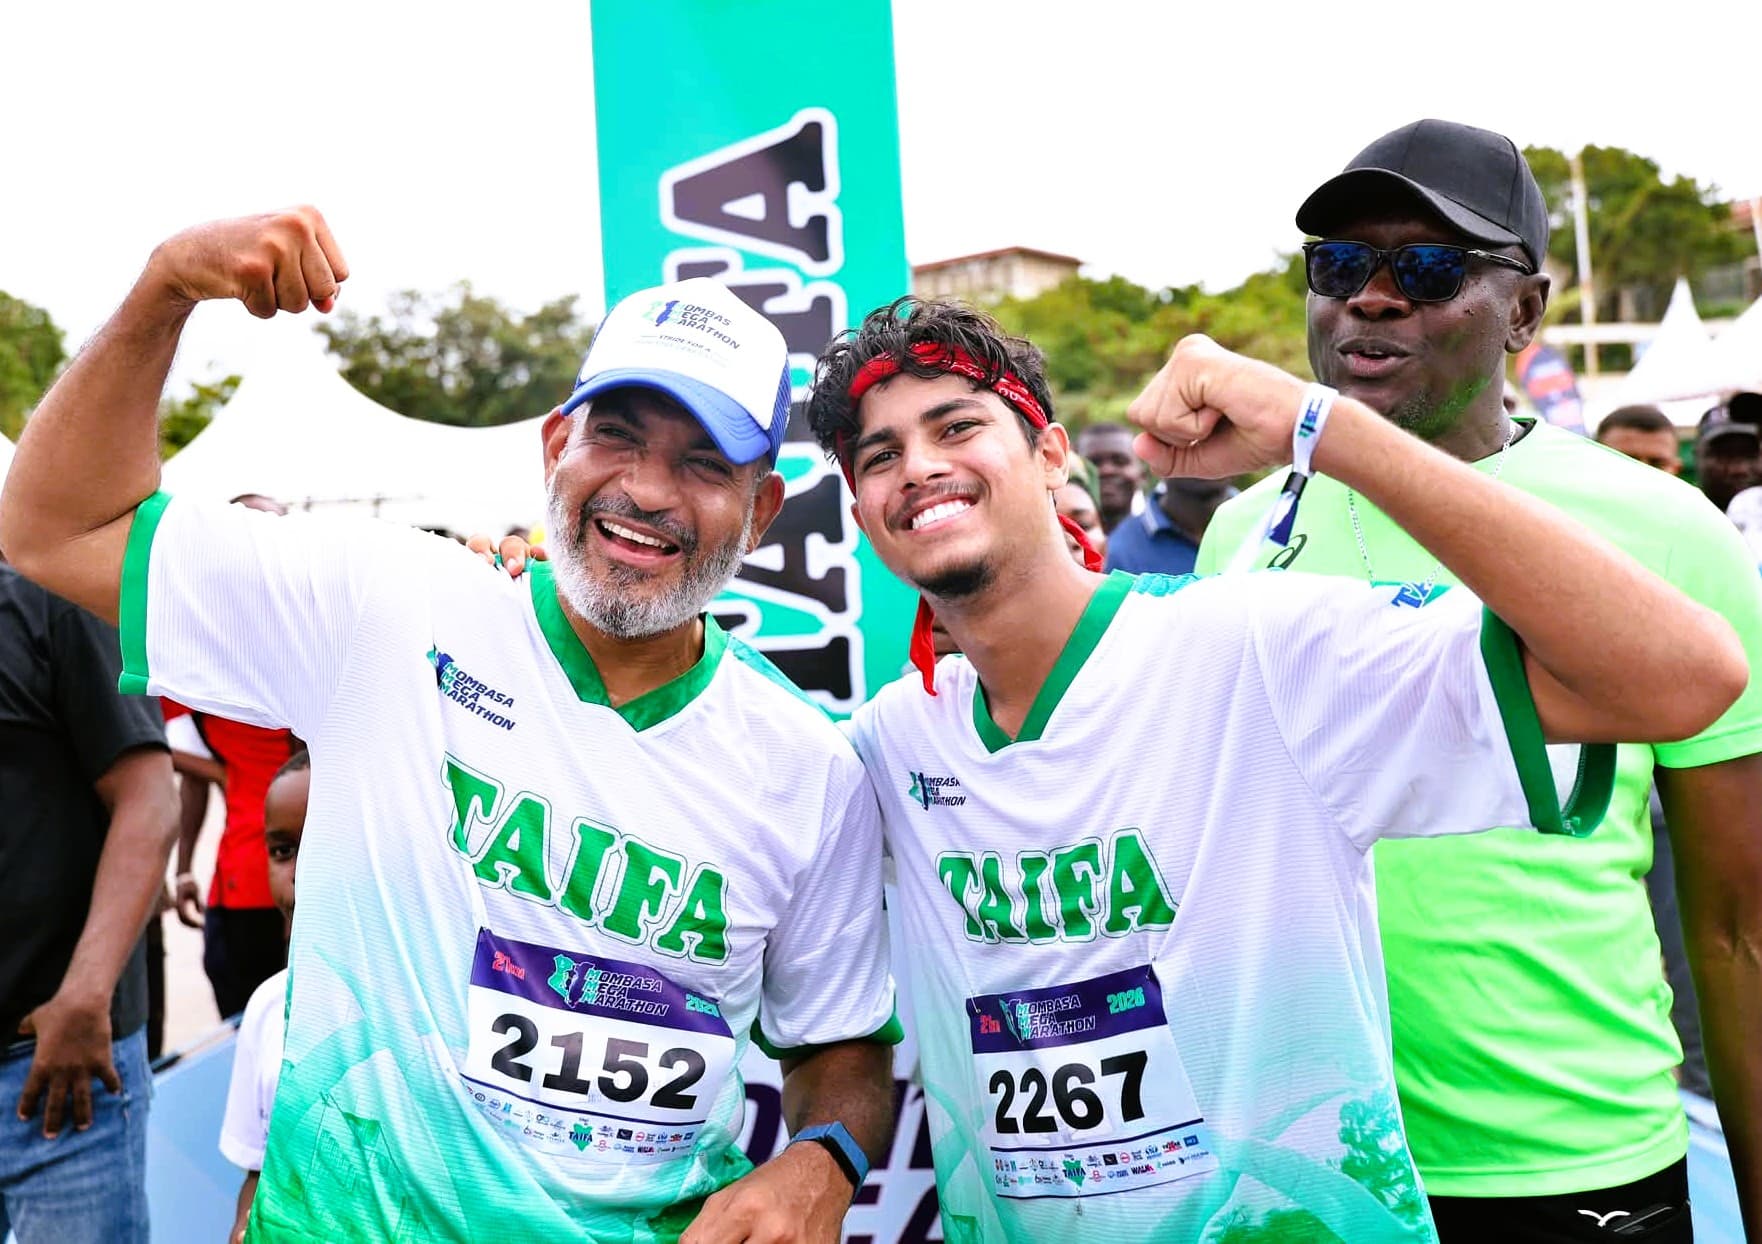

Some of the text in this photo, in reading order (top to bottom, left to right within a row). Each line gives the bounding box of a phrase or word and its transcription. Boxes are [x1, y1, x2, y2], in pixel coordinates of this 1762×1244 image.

[441, 671, 480, 702] MEGA
[445, 662, 515, 708] MOMBASA
[439, 682, 516, 731] MARATHON
[442, 754, 731, 964] TAIFA
[937, 829, 1178, 943] TAIFA
[581, 978, 629, 999] MEGA
[584, 967, 662, 993] MOMBASA
[579, 990, 669, 1017] MARATHON
[1016, 994, 1082, 1017] MOMBASA
[1107, 986, 1146, 1014] 2026
[1018, 1012, 1057, 1029] MEGA
[1021, 1015, 1096, 1040] MARATHON
[491, 1013, 706, 1110] 2152
[989, 1050, 1148, 1134] 2267
[569, 1131, 593, 1143] TAIFA
